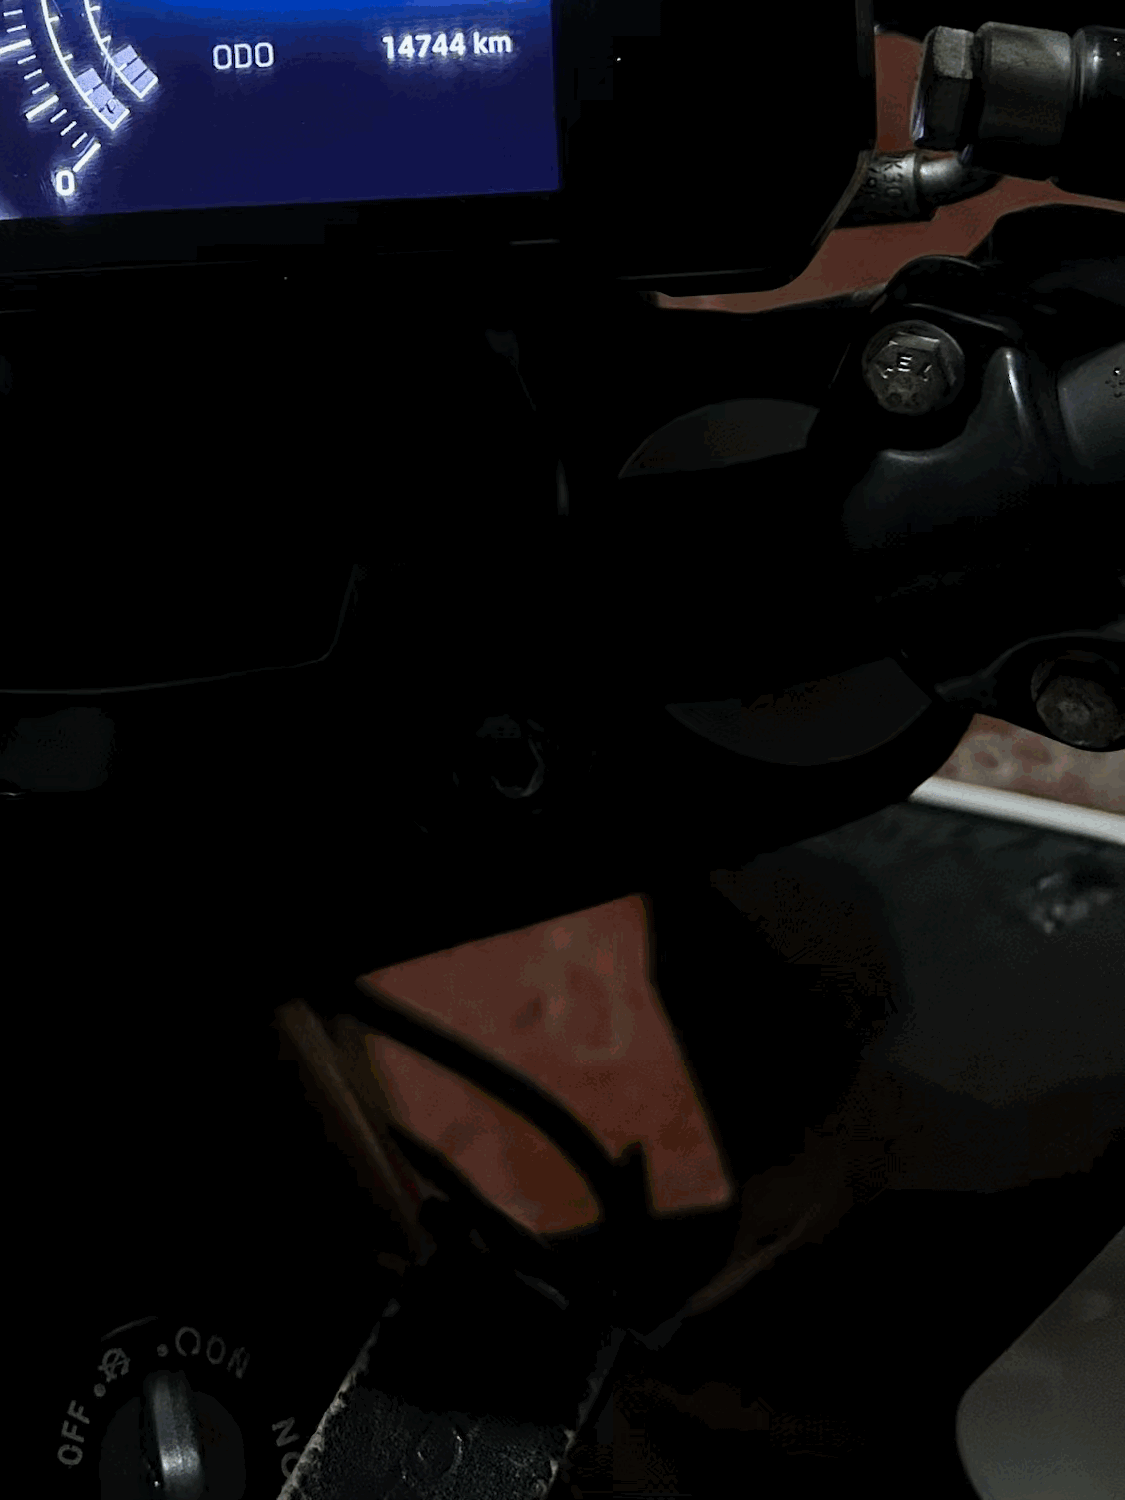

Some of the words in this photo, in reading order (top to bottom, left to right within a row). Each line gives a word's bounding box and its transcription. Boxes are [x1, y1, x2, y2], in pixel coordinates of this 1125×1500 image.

[212, 42, 274, 70] ODO
[382, 32, 466, 60] 14744
[473, 31, 513, 55] km
[55, 169, 74, 197] 0
[58, 1400, 91, 1467] OFF
